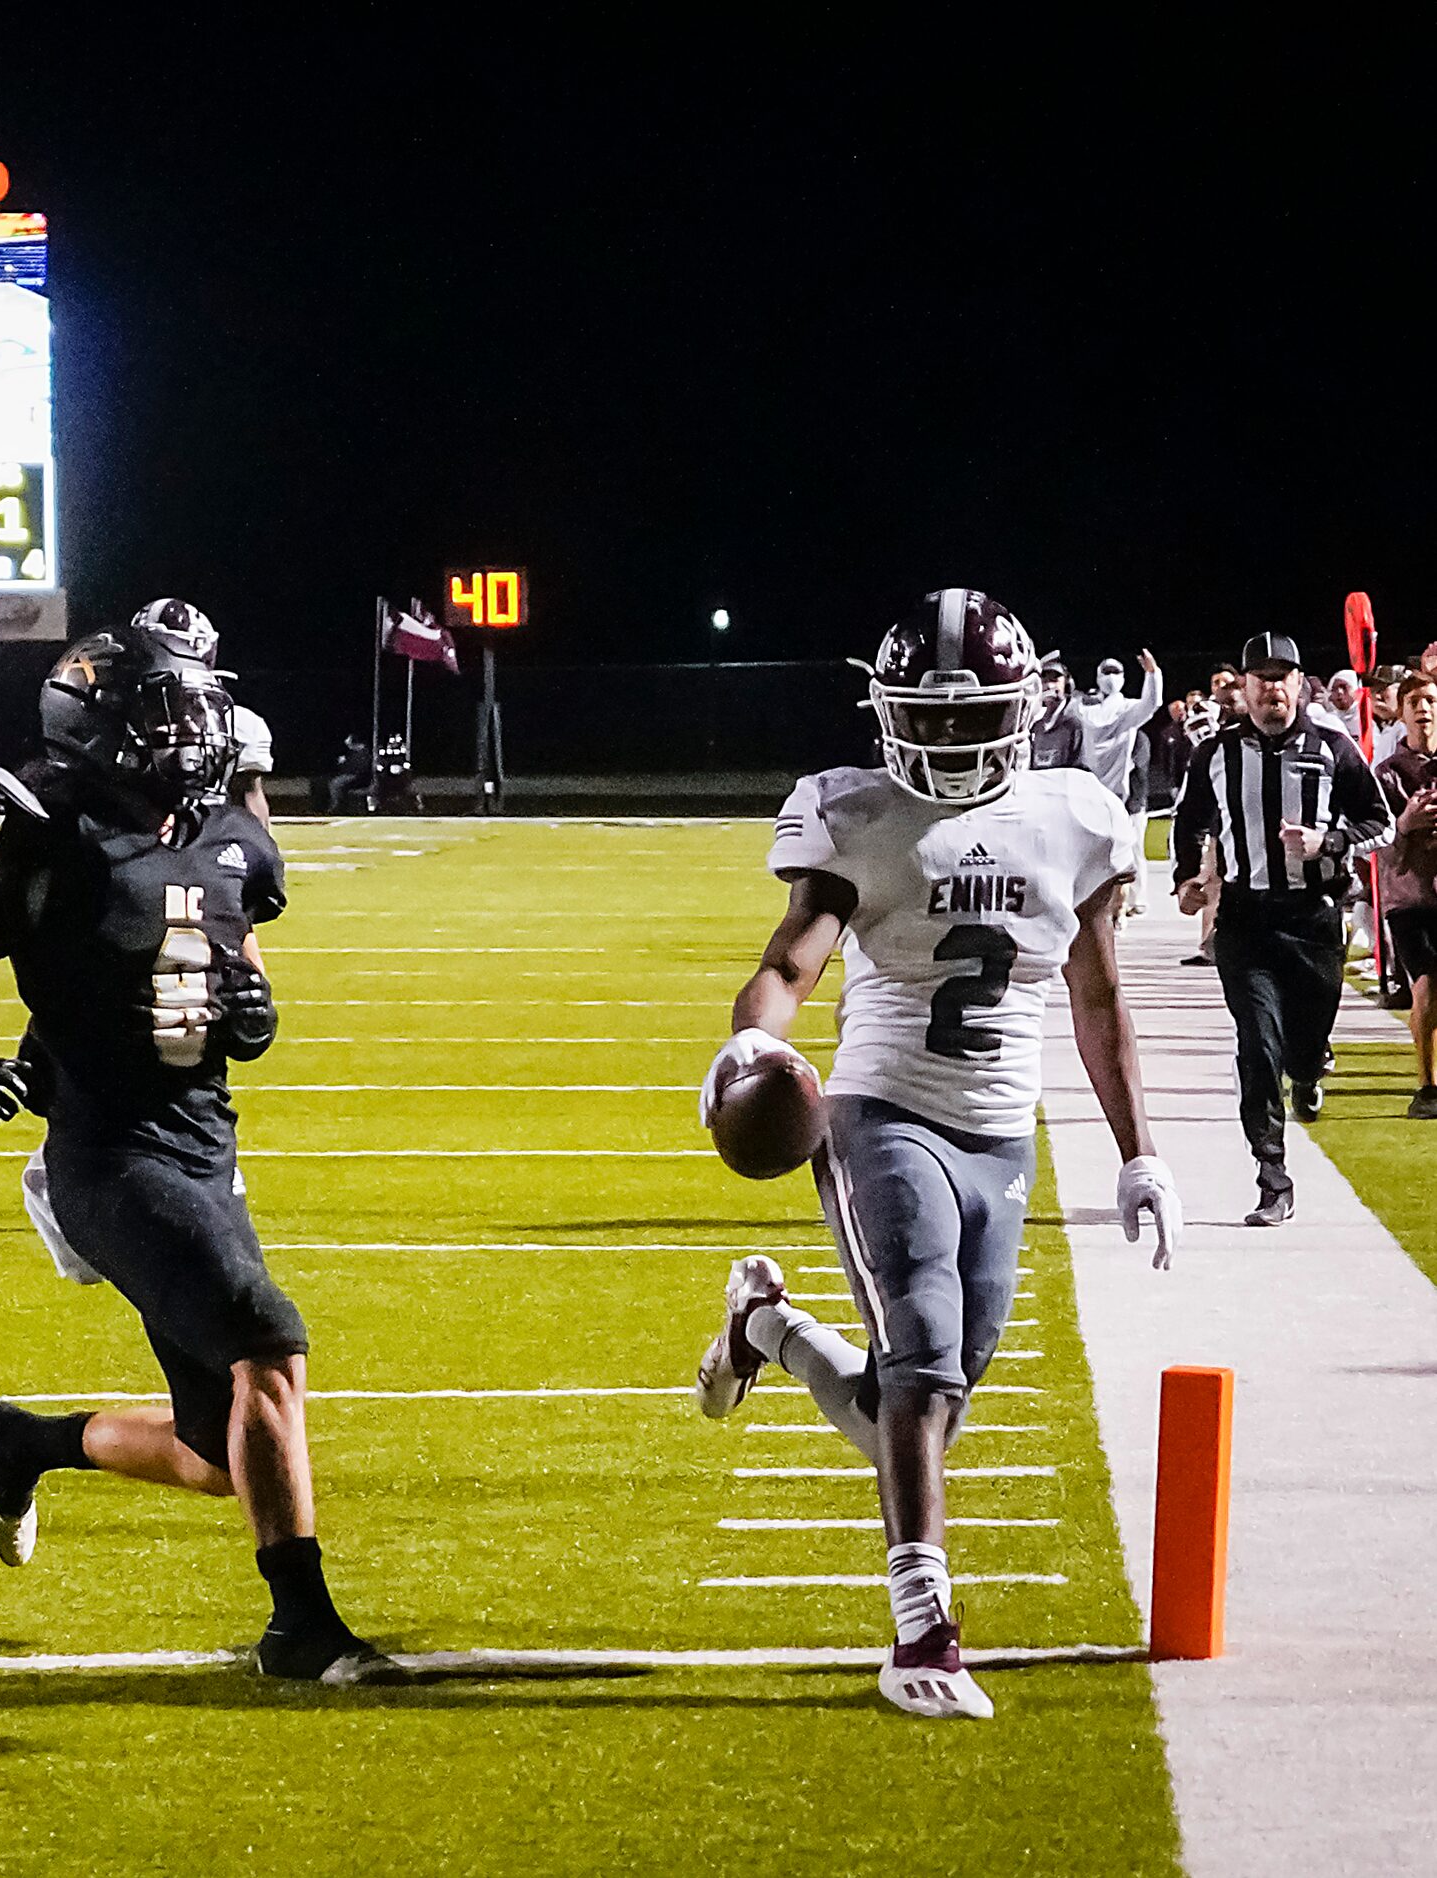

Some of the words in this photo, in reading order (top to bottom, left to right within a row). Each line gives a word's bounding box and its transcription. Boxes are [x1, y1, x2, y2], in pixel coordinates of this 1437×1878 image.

[20, 548, 46, 580] 4
[450, 571, 519, 625] 40
[928, 875, 1027, 914] ENNIS
[925, 924, 1018, 1061] 2
